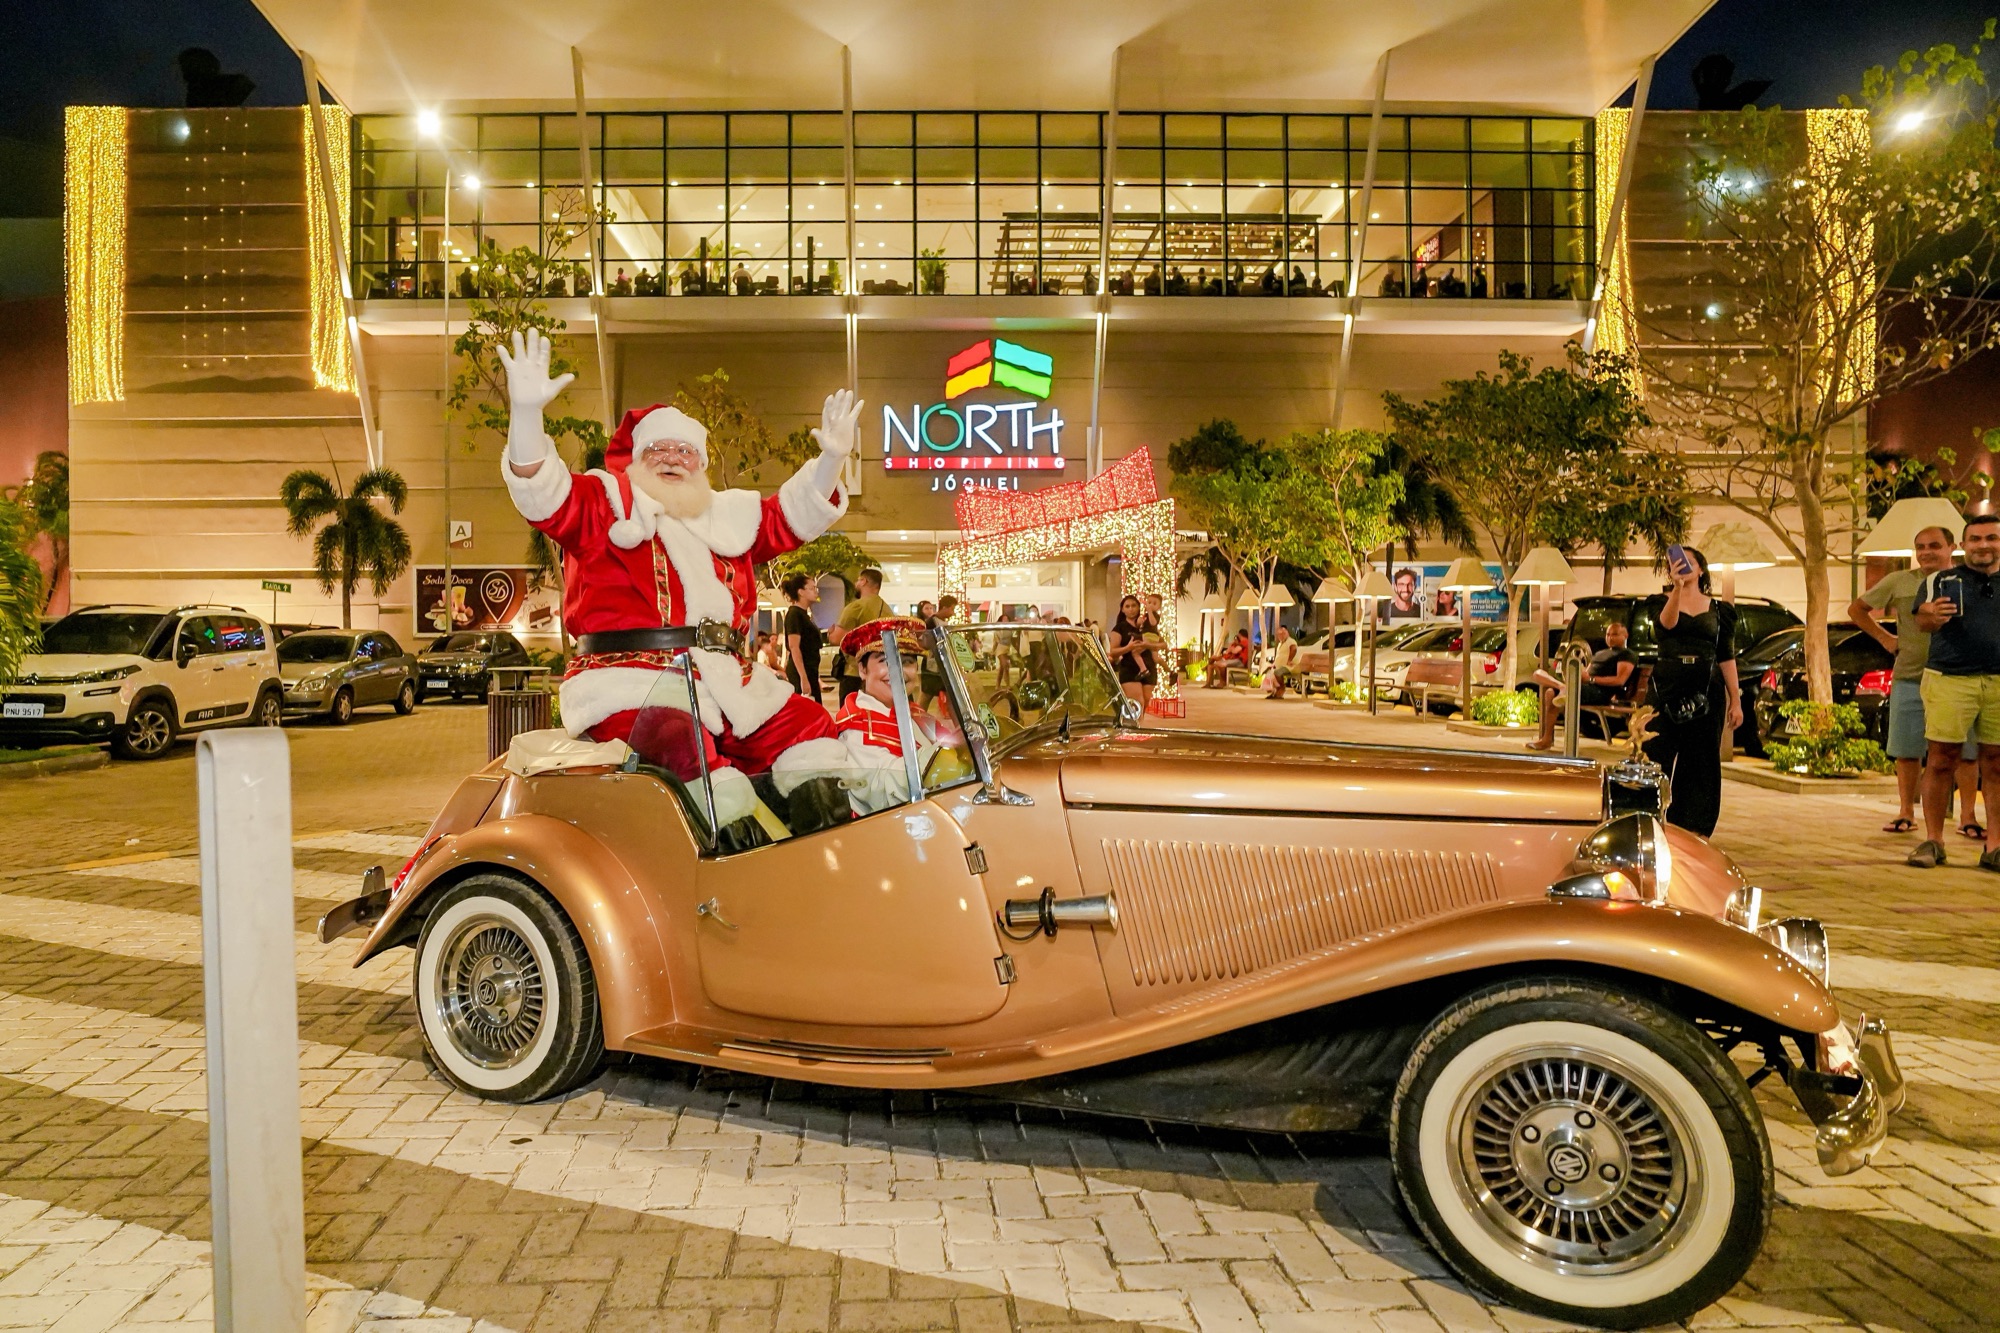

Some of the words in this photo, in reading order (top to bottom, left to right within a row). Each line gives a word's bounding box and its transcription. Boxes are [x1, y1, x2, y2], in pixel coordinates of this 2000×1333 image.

[883, 402, 1064, 454] NORTH
[884, 457, 1065, 468] SHOPPING
[456, 524, 466, 536] A
[985, 576, 993, 585] A
[198, 709, 214, 720] AIR
